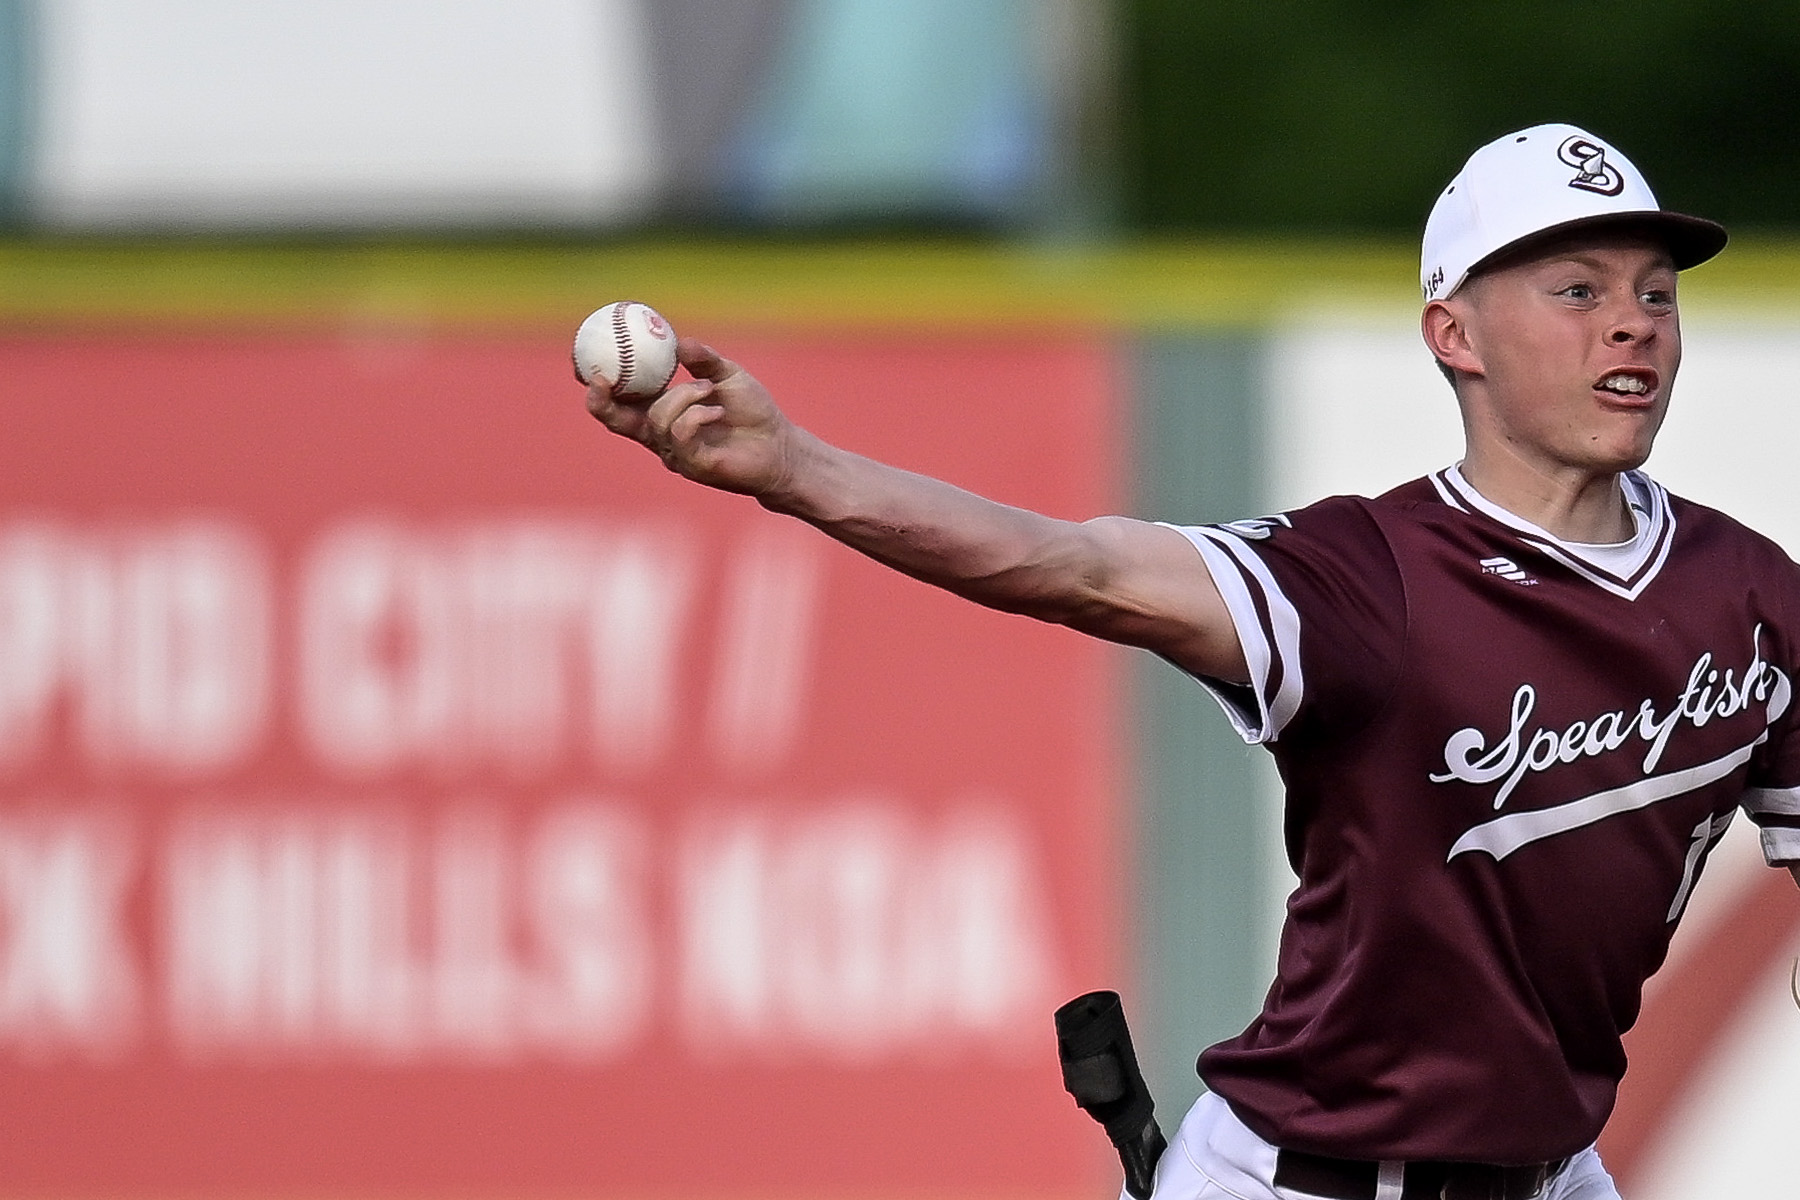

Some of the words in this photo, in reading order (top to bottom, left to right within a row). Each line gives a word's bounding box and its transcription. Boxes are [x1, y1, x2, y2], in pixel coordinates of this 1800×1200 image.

[297, 517, 700, 778] CITY
[1429, 622, 1791, 810] Spearfish
[162, 805, 655, 1058] HILLS
[672, 805, 1058, 1056] KOA
